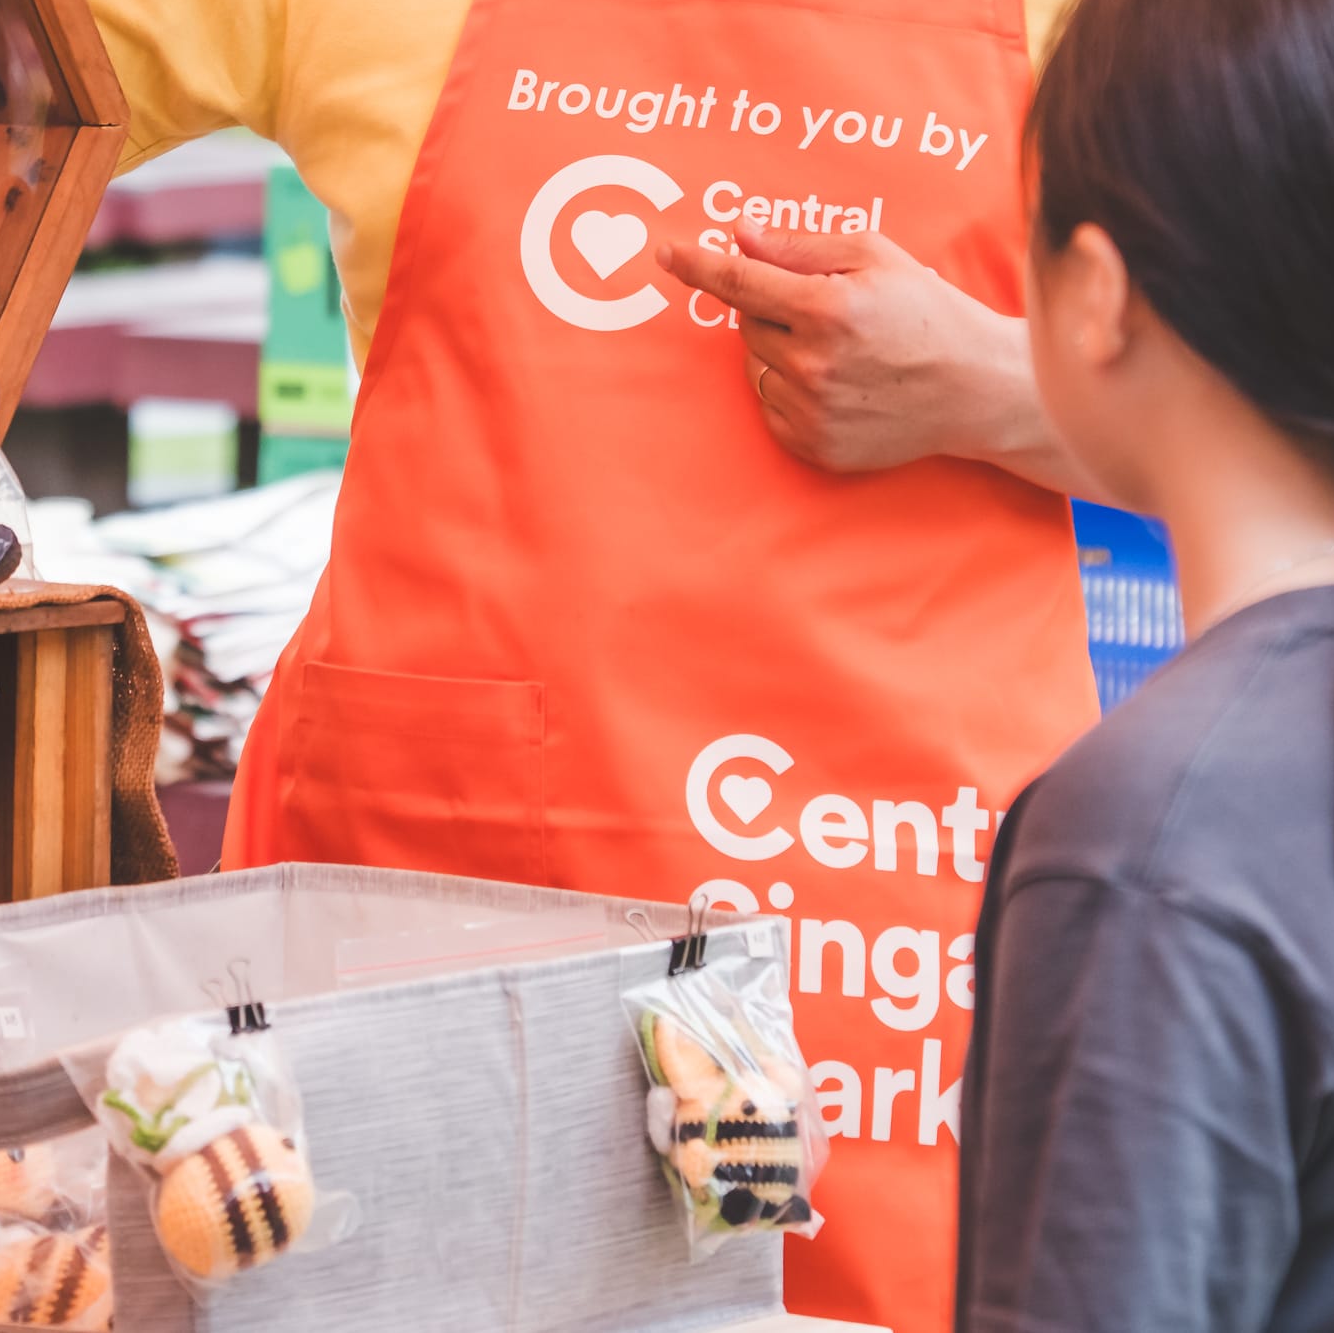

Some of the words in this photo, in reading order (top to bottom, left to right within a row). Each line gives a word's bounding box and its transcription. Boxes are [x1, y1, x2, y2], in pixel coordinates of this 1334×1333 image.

[507, 69, 717, 133] Brought
[730, 89, 782, 135] to
[798, 106, 903, 150] you
[918, 112, 988, 171] by
[702, 180, 884, 235] Central
